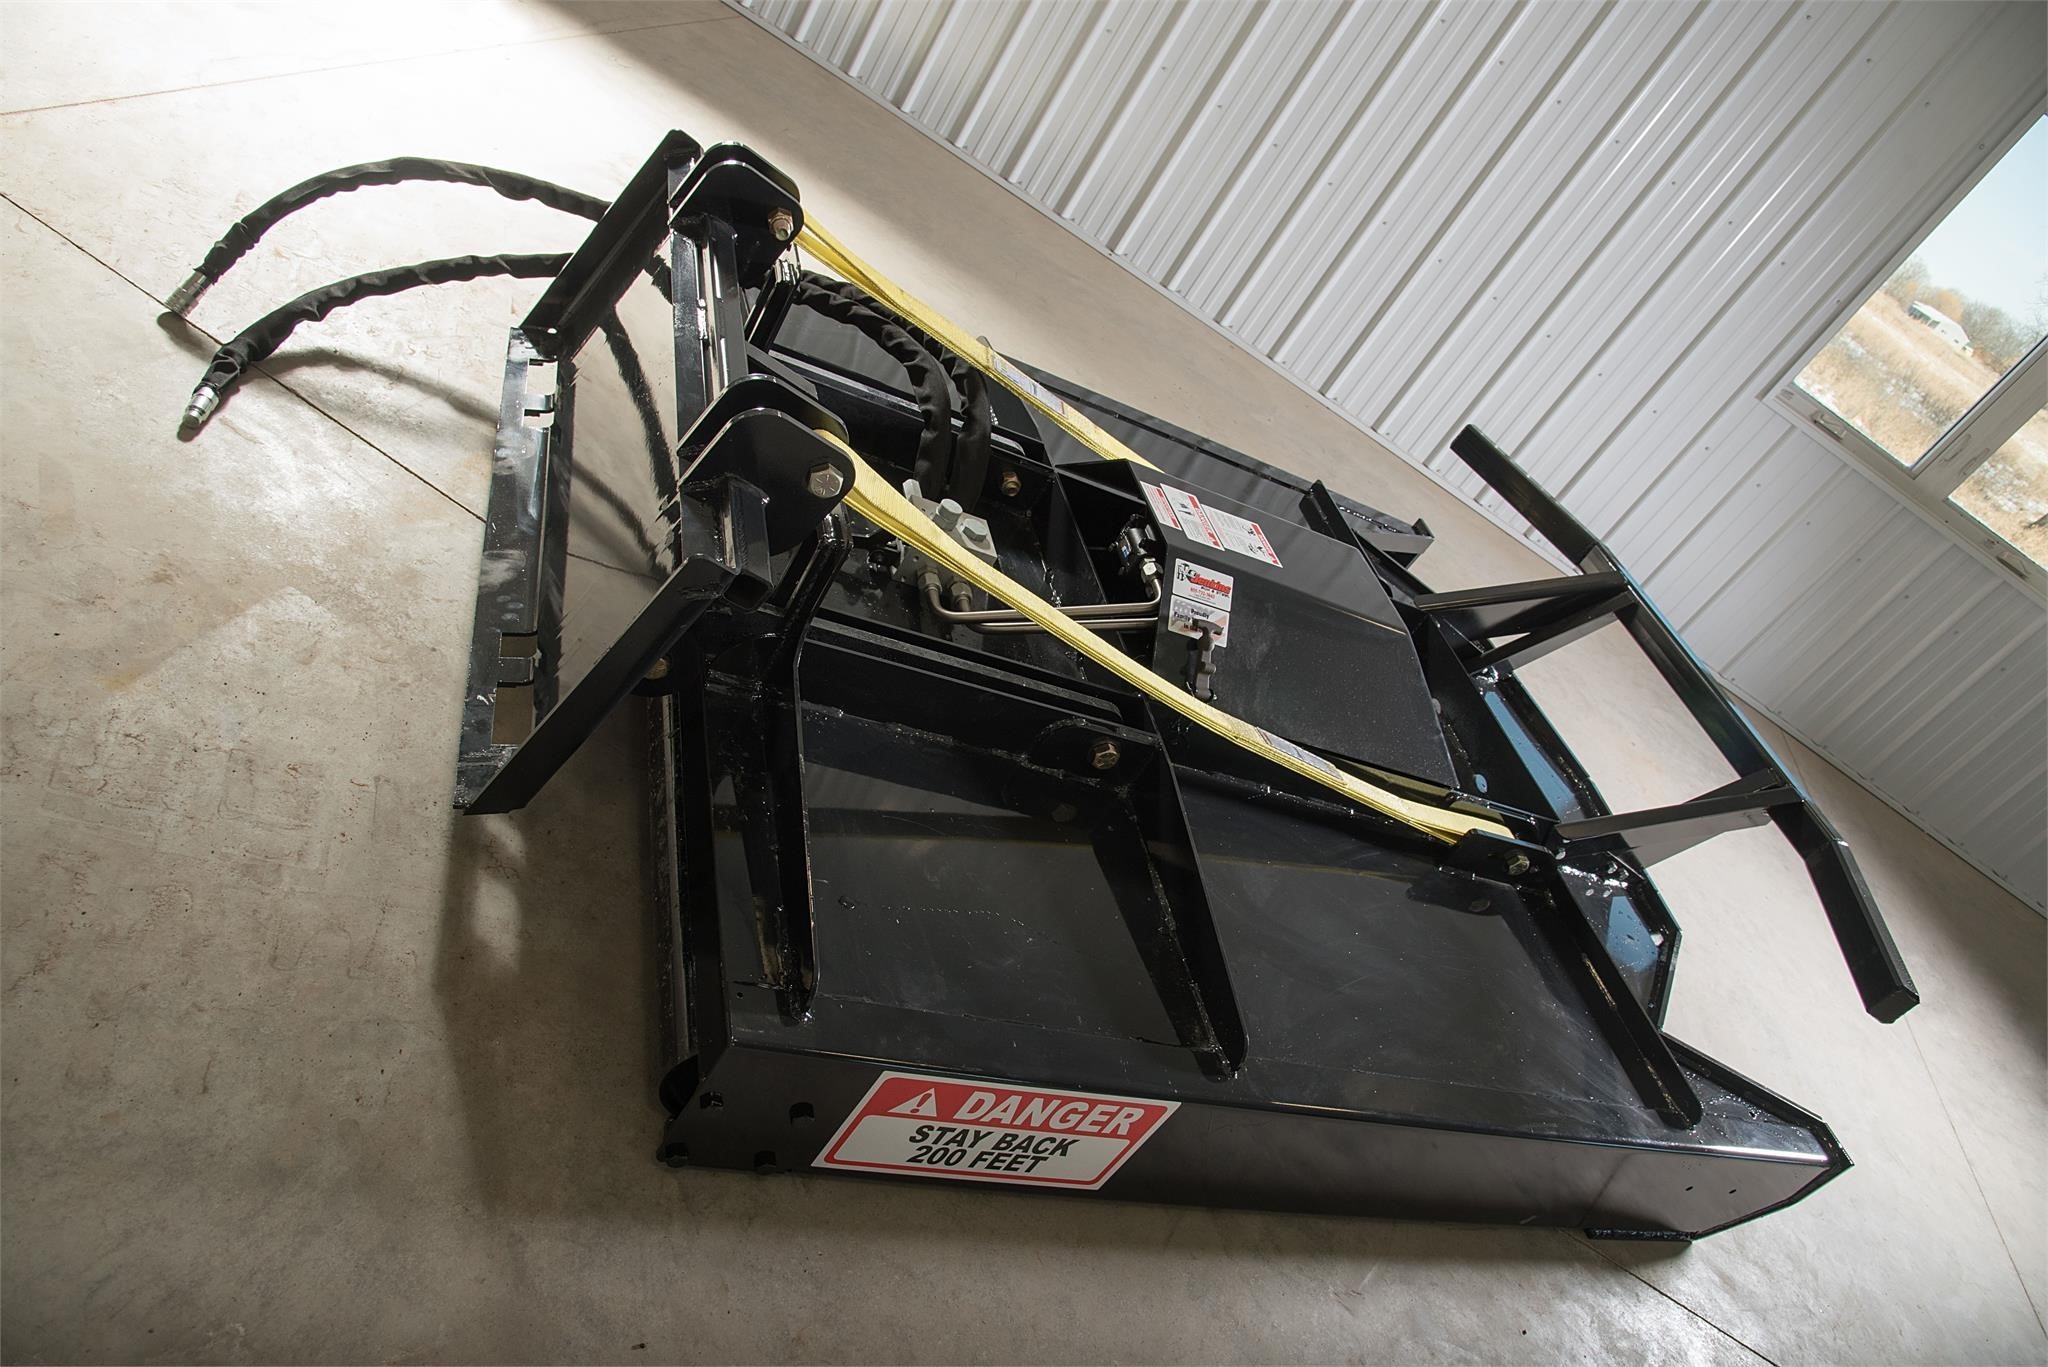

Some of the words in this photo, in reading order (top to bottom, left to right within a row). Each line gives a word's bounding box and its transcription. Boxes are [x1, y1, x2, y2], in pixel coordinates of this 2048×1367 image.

[953, 1091, 1145, 1136] DANGER
[908, 1125, 993, 1149] STAY
[990, 1133, 1081, 1157] BACK
[906, 1145, 968, 1167] 200
[968, 1151, 1049, 1174] FEET
